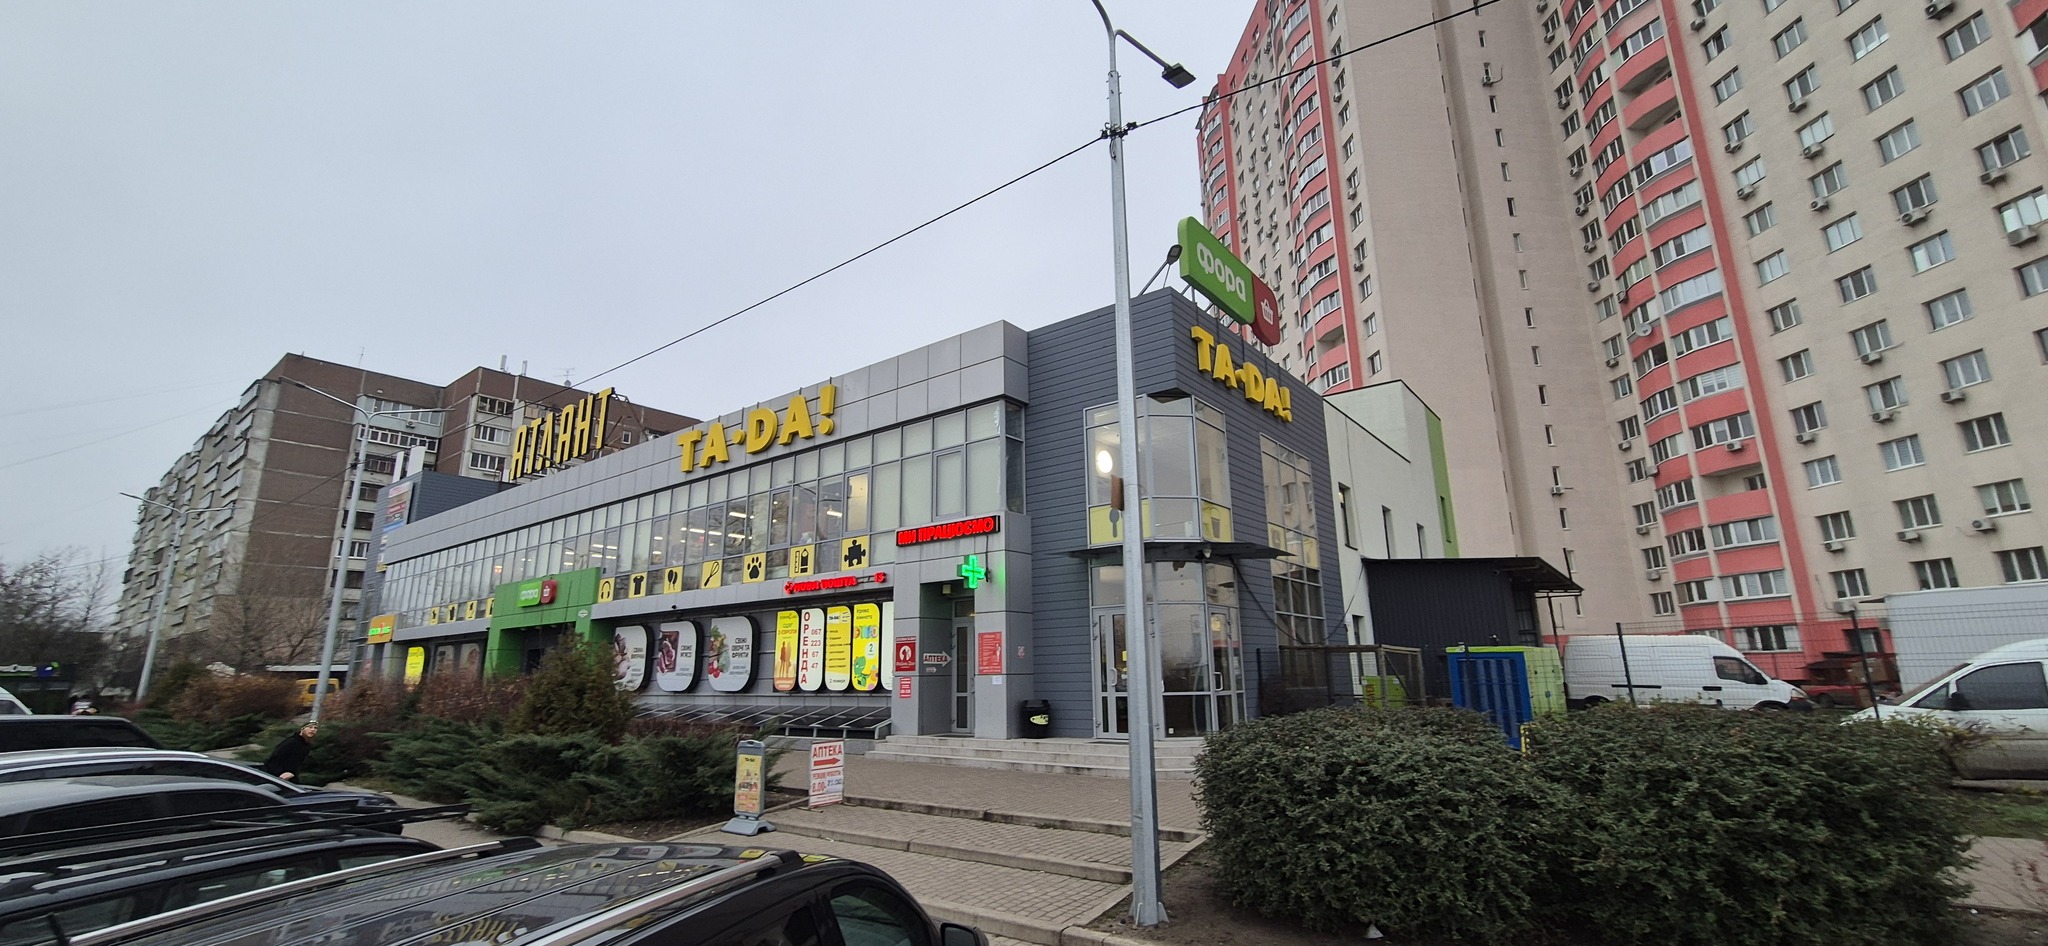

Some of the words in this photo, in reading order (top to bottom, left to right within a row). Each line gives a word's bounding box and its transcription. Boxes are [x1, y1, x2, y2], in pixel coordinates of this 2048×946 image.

[1196, 241, 1247, 303] фора
[509, 386, 616, 481] АТЛАНТ
[897, 529, 917, 545] МИ
[918, 516, 995, 543] ПРАЦЮЄМО
[810, 639, 821, 647] 223
[811, 628, 822, 636] 067
[801, 611, 811, 684] ОРЕНДА
[924, 654, 948, 663] АПТЕКА
[812, 744, 843, 759] АПТЕКА
